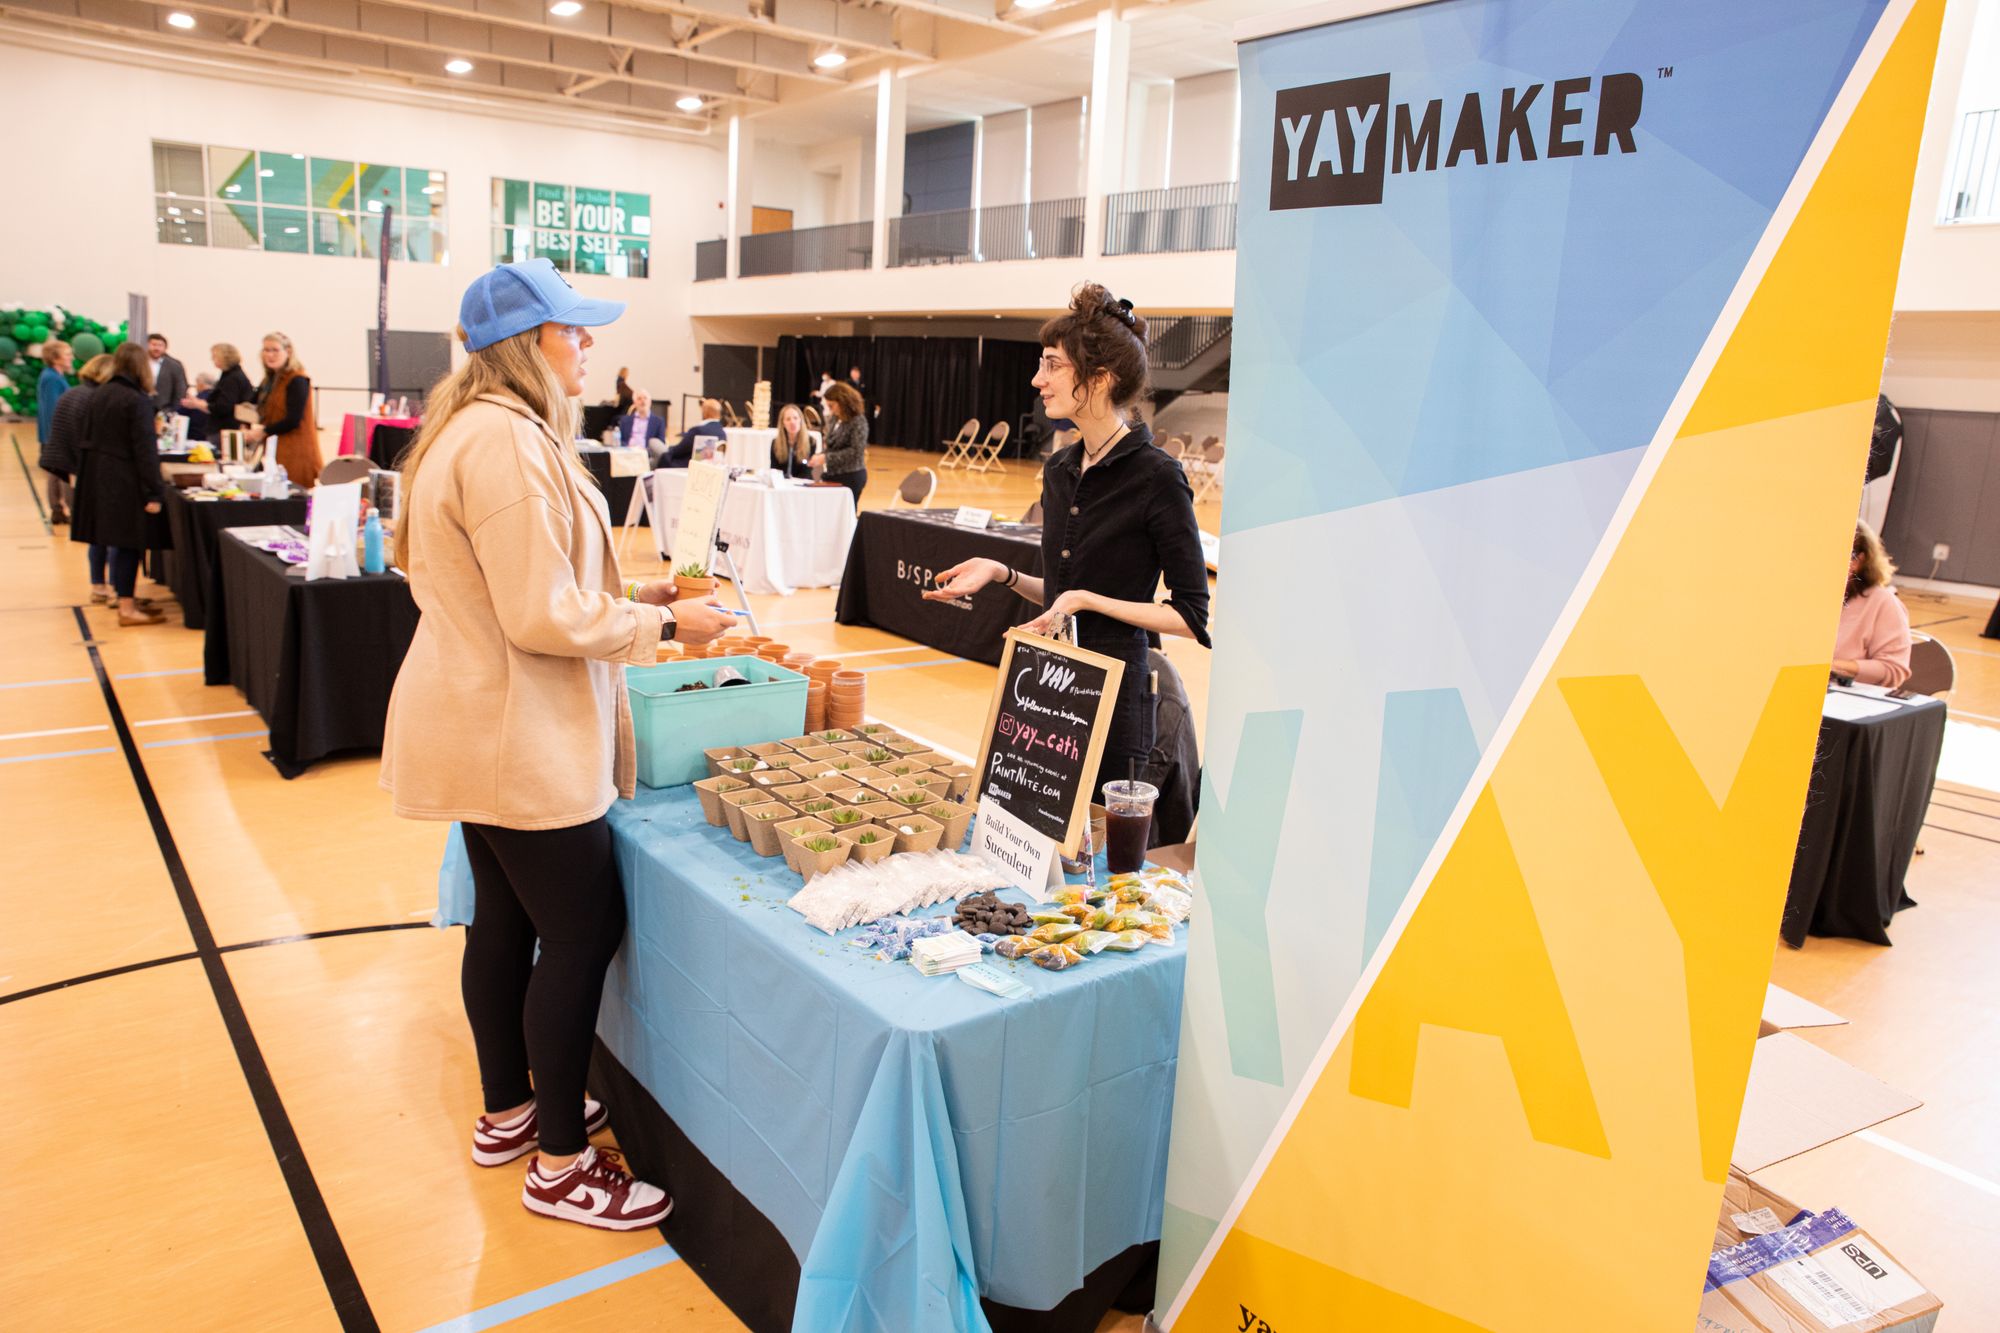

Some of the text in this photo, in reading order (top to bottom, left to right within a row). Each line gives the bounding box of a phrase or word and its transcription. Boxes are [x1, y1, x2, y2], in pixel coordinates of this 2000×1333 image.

[536, 200, 627, 234] BE YOUR
[1039, 661, 1076, 693] YAY
[1012, 721, 1079, 761] yay_cath
[985, 814, 1041, 860] Build Your Own
[985, 834, 1033, 880] Succulent
[1843, 1244, 1886, 1280] UPS
[1238, 1304, 1277, 1333] ya
